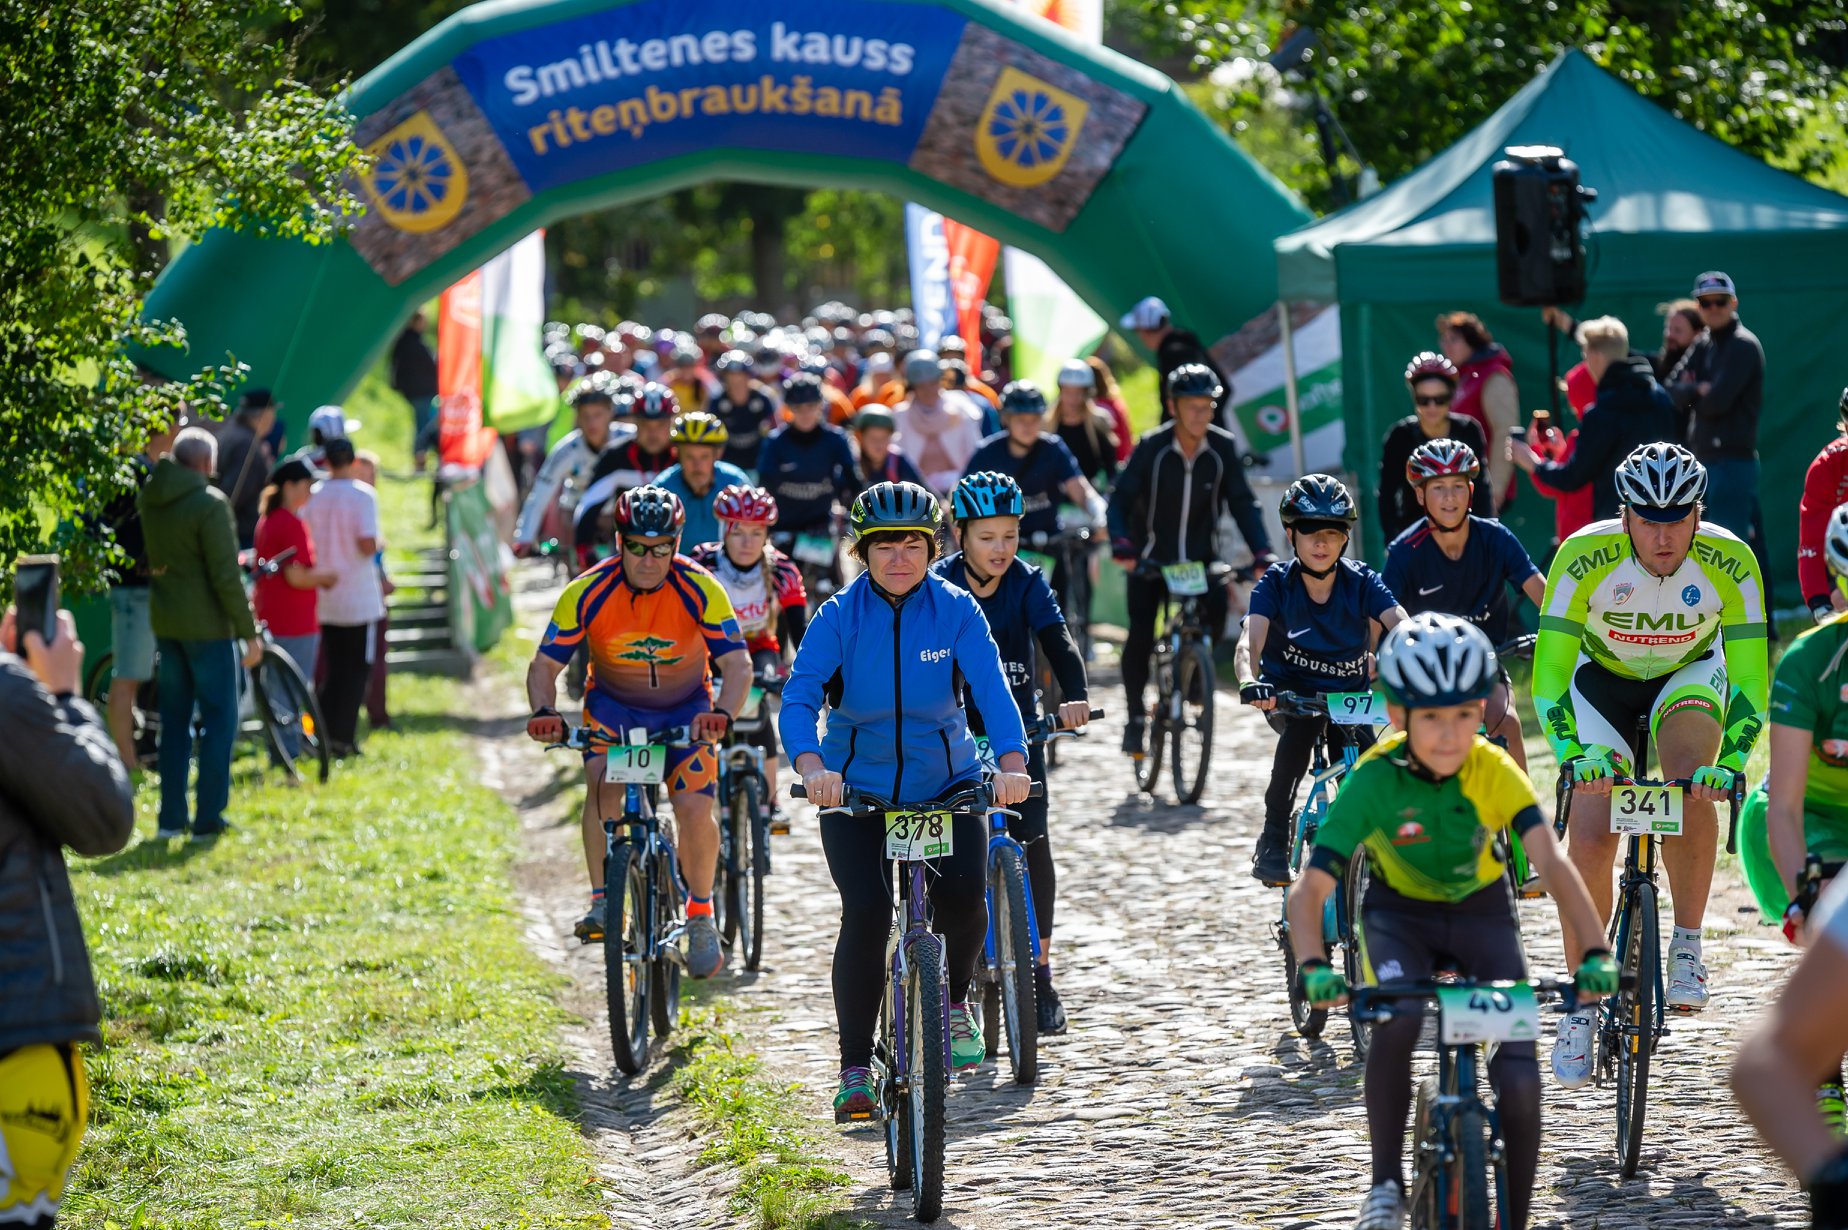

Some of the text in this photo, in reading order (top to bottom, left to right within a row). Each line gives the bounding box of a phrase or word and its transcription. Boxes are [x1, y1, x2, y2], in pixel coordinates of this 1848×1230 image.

[504, 21, 915, 106] Smiltenes kauss
[528, 74, 902, 155] riteņbraukšanā
[1566, 542, 1621, 581] EMU
[1694, 540, 1751, 584] EMU
[1602, 611, 1706, 631] EMU
[1613, 633, 1692, 644] NUTREND
[920, 648, 951, 663] Eiger
[1343, 696, 1373, 714] 97
[1663, 699, 1711, 718] NUTREND
[1547, 705, 1574, 741] EMU
[1736, 715, 1762, 754] EMU
[624, 748, 651, 768] 10
[1620, 789, 1670, 816] 341
[894, 814, 944, 841] 378
[1468, 989, 1514, 1014] 40
[1571, 1016, 1590, 1026] SIDI
